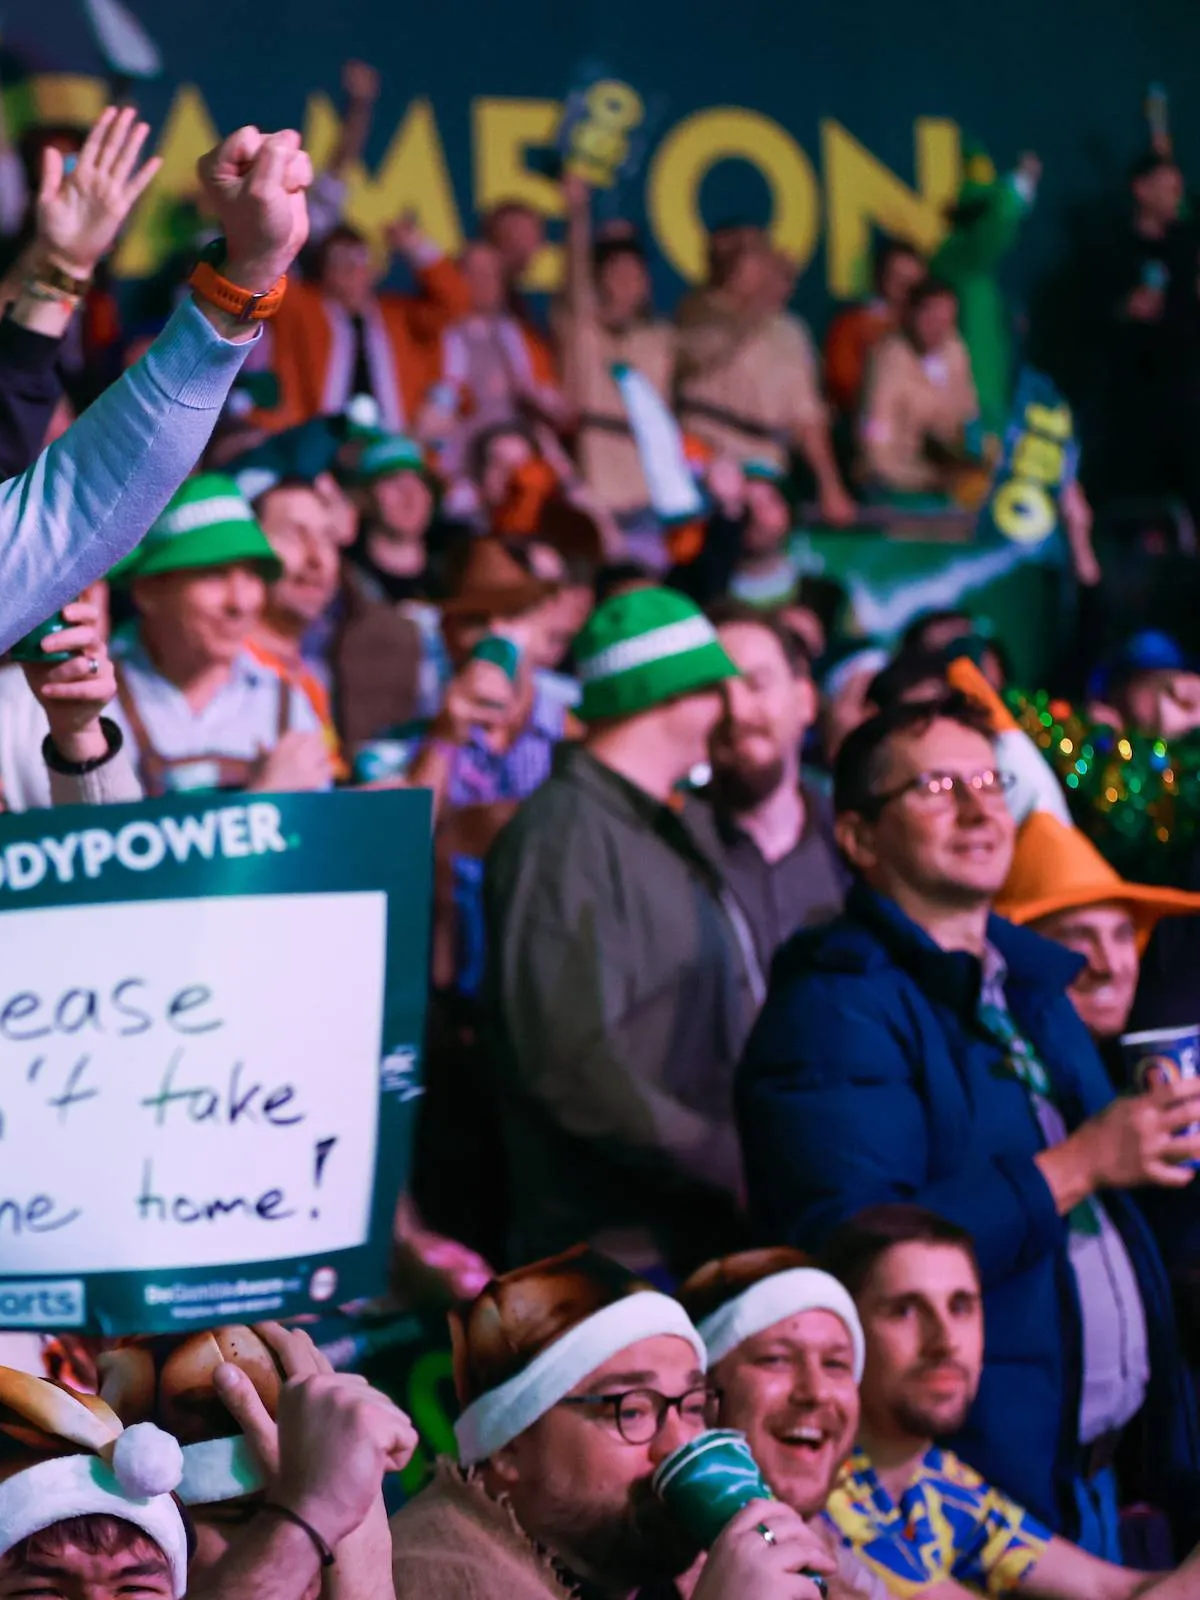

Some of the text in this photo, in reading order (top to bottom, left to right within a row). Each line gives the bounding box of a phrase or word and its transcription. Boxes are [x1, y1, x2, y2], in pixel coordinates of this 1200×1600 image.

[646, 104, 960, 300] ON
[139, 1046, 306, 1127] take
[136, 1135, 338, 1222] home!
